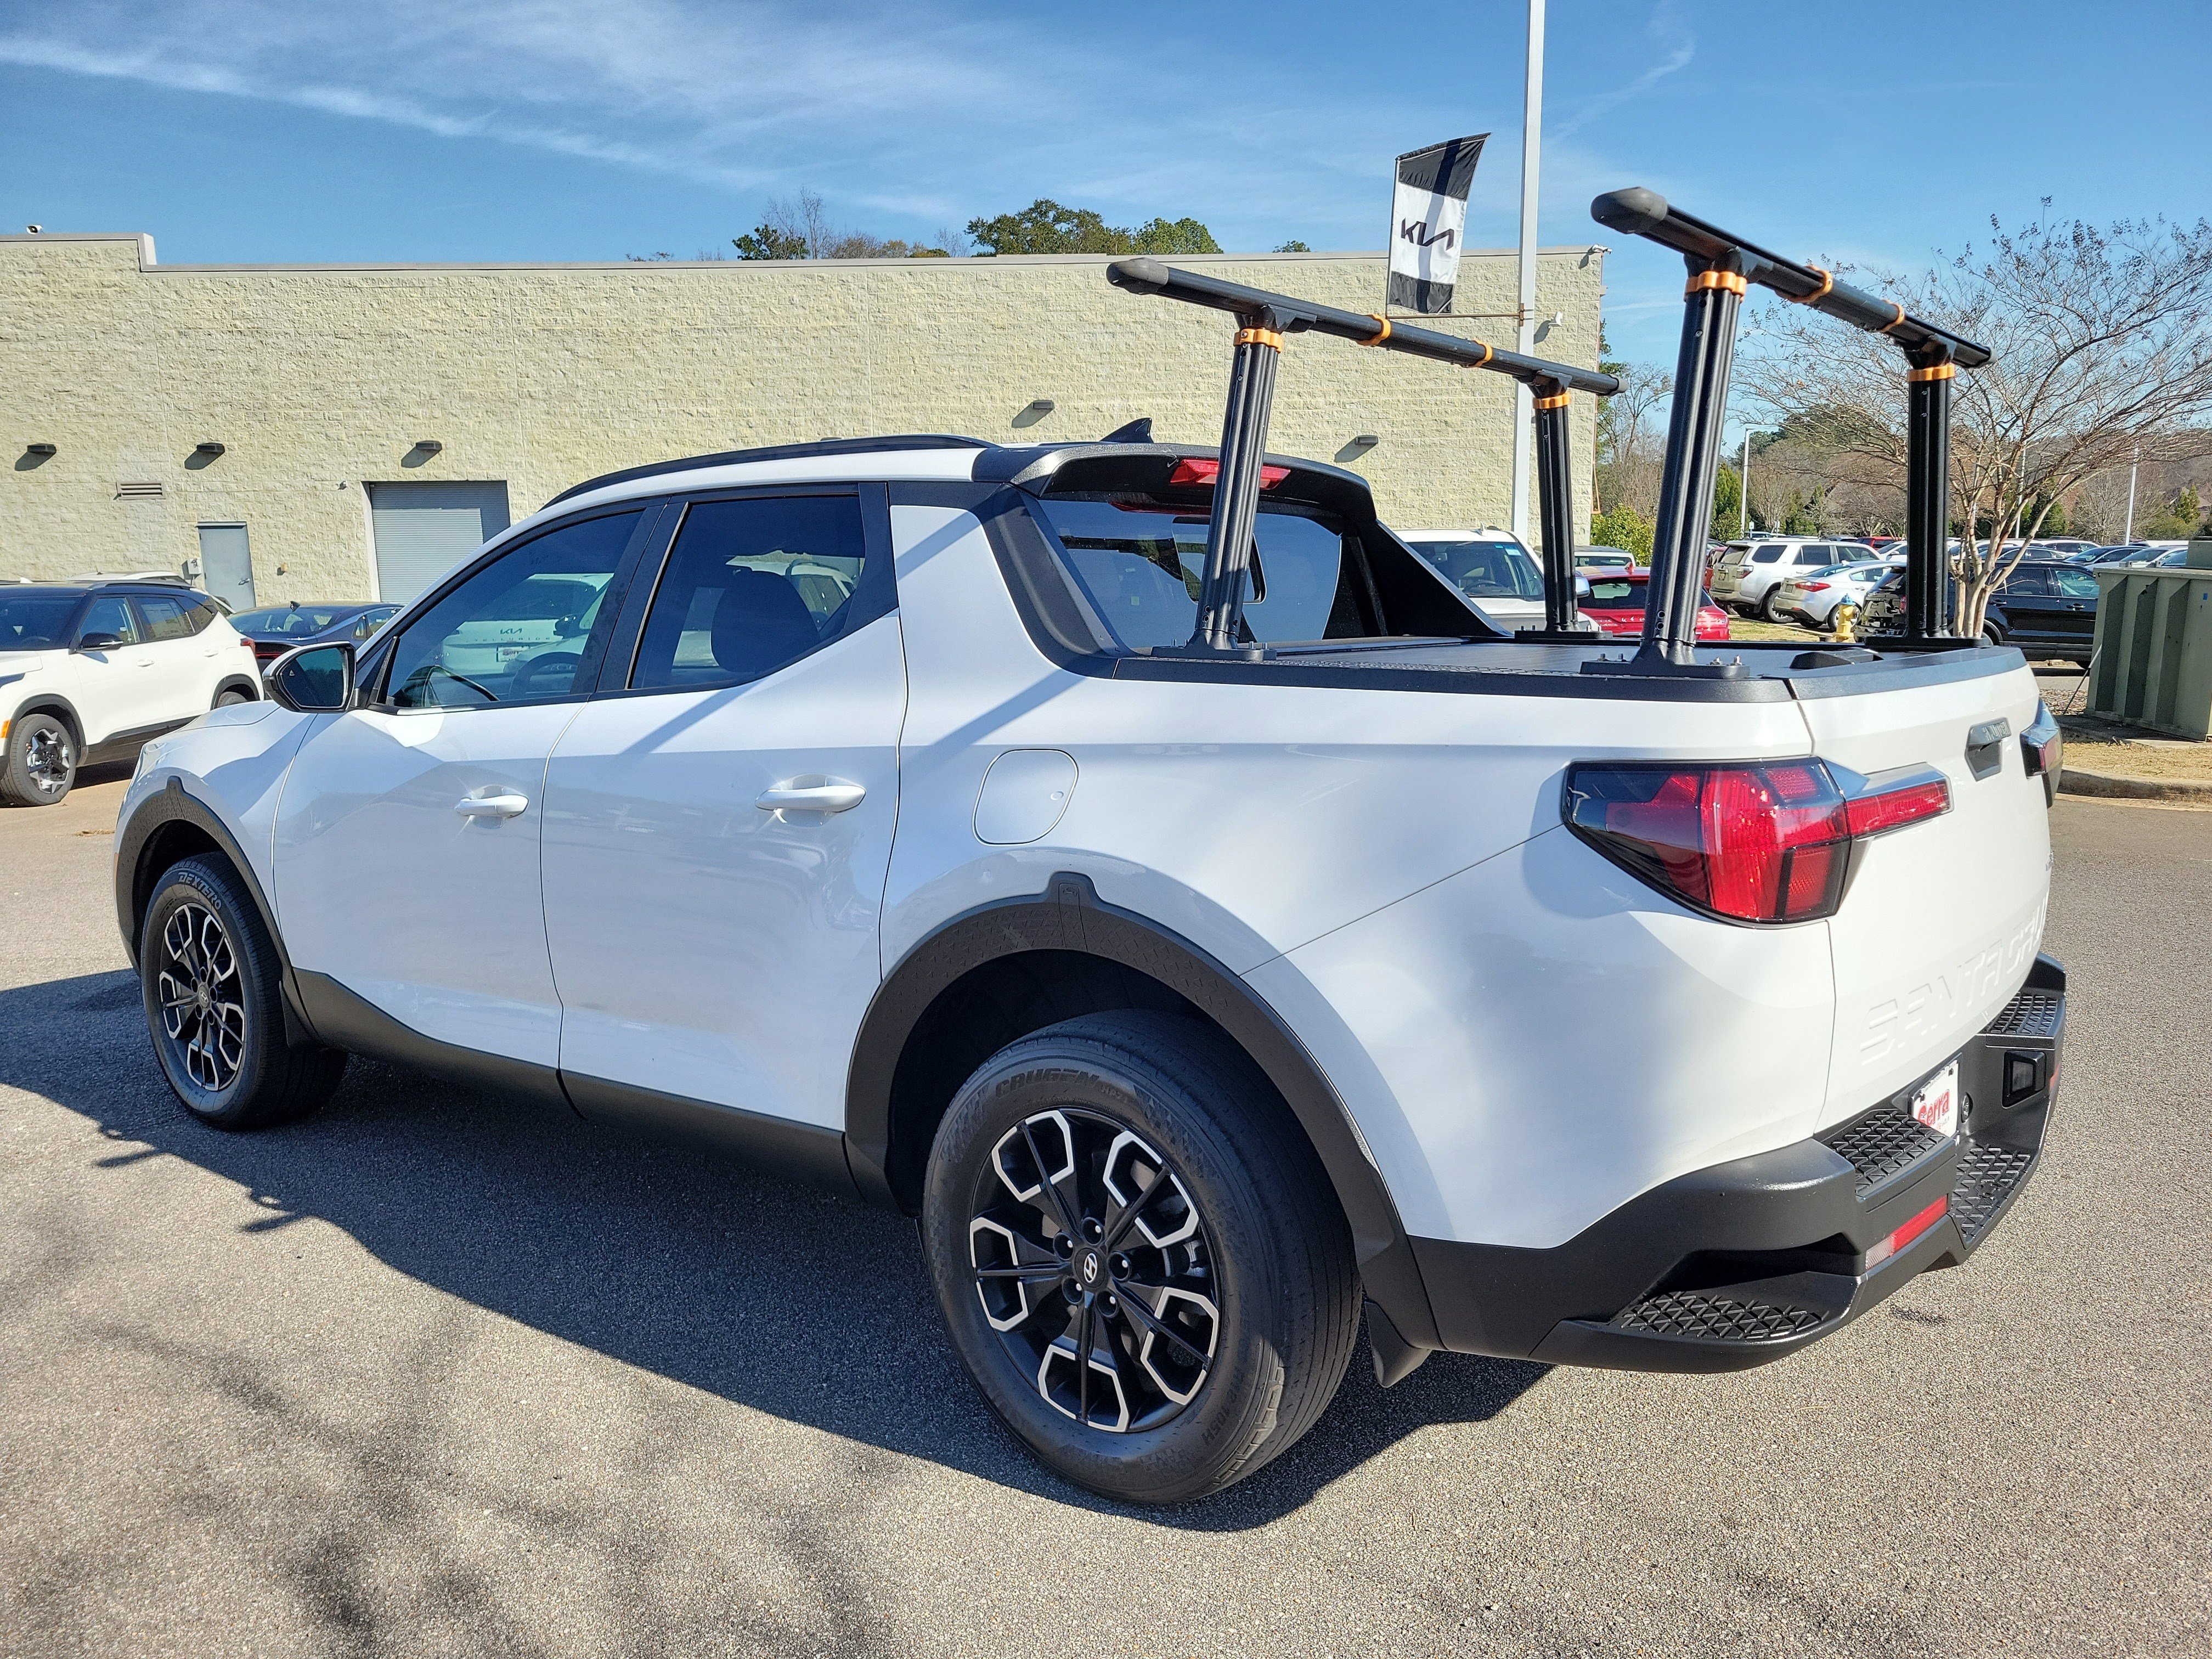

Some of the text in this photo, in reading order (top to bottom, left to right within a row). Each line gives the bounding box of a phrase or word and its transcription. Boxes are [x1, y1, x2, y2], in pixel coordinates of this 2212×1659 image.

[1401, 217, 1454, 251] KIA
[178, 872, 222, 910] DEXTERO
[995, 1068, 1099, 1098] CRUGEN
